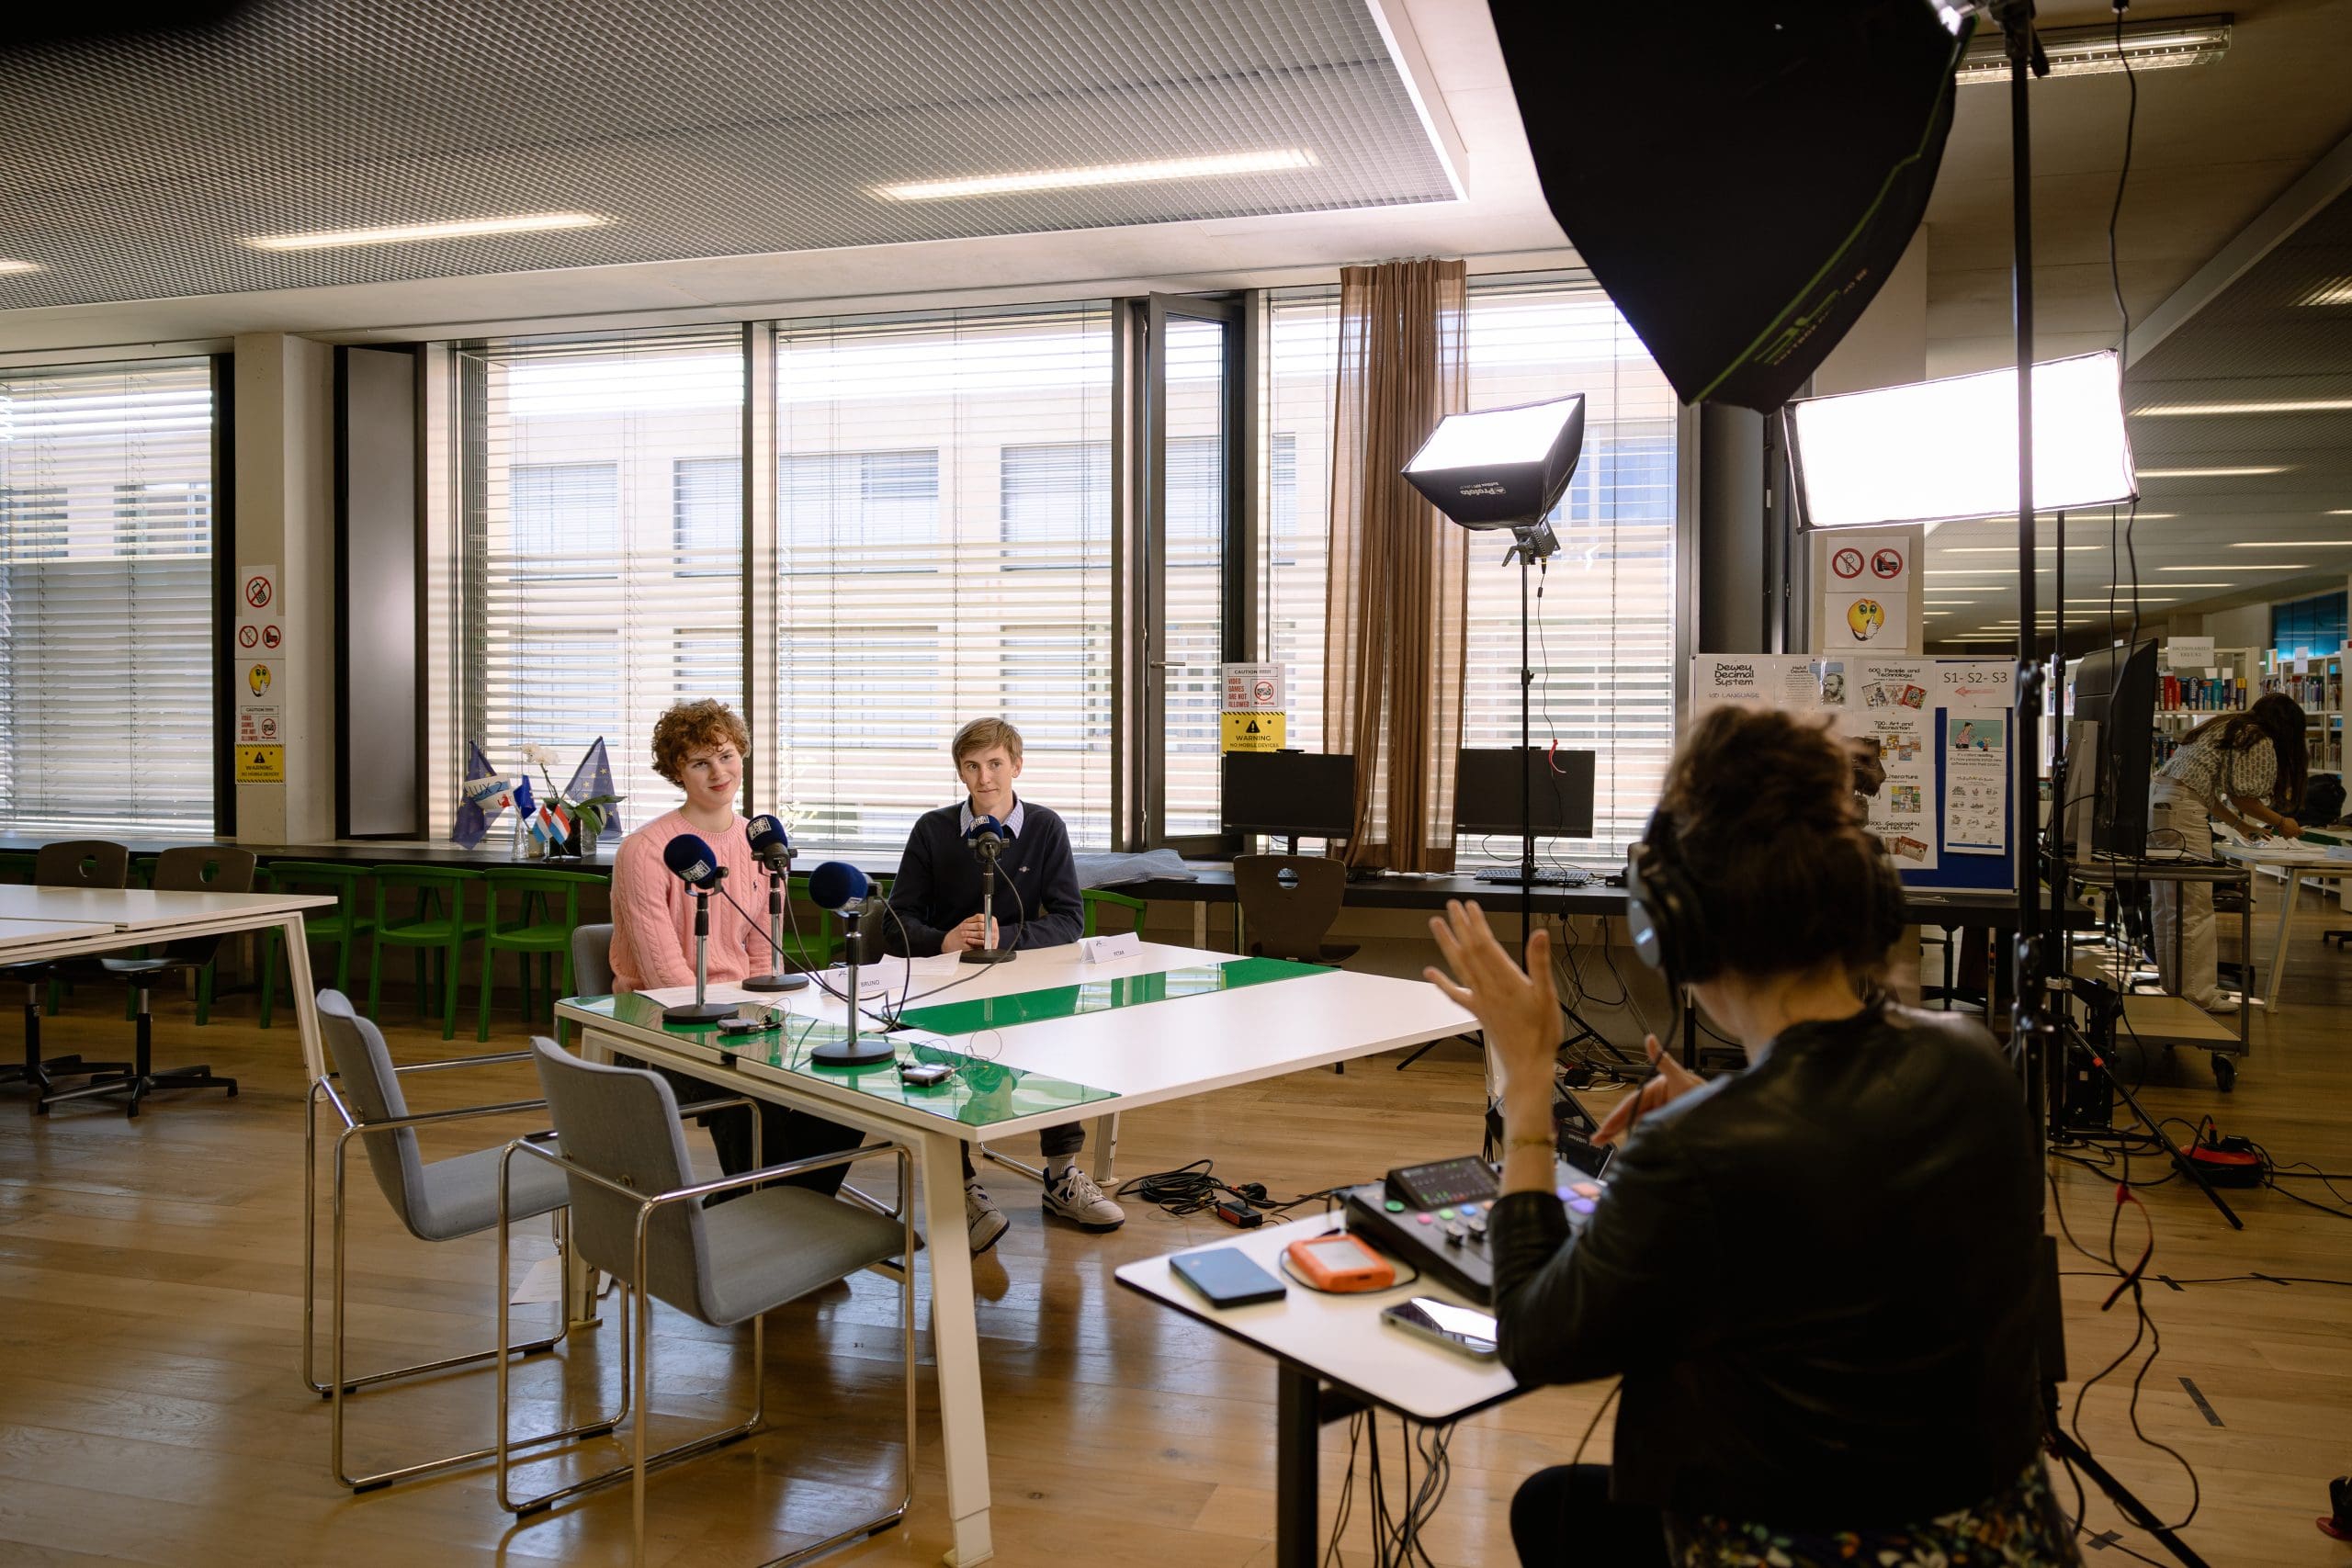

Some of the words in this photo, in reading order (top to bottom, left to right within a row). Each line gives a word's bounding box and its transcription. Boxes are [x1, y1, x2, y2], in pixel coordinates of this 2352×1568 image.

[1460, 488, 1496, 496] Profoto
[1716, 662, 1752, 672] Dewey
[1714, 670, 1755, 679] Decimal
[1992, 672, 2007, 683] S3
[1714, 678, 1754, 687] System
[860, 979, 880, 987] BRUNO
